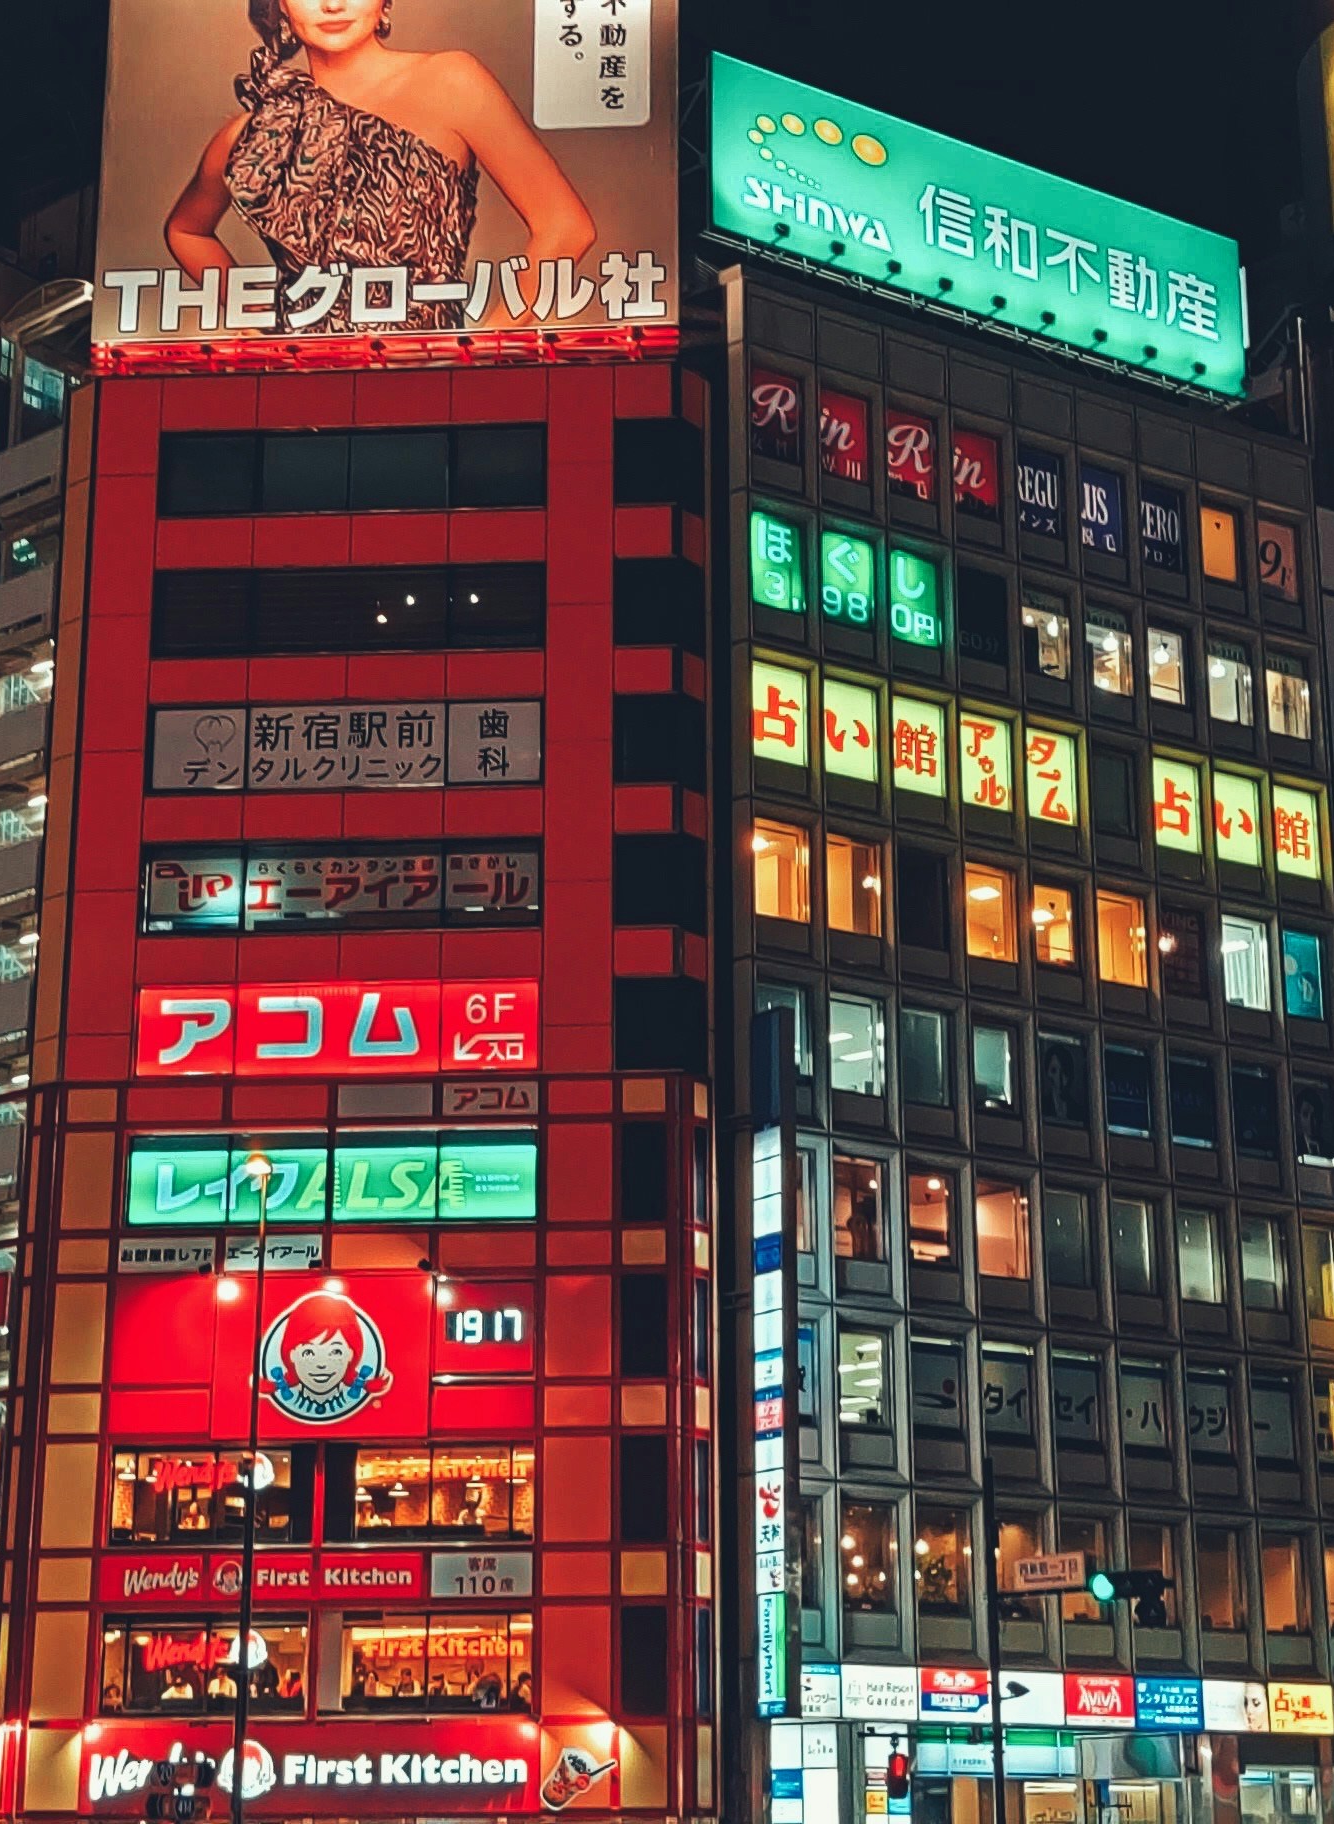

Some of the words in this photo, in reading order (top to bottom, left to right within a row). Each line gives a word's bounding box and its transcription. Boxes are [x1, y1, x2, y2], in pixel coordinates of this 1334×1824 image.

[918, 183, 1222, 341] 信和不動産
[103, 251, 668, 333] THEグローバル社
[757, 519, 925, 599] ほぐし
[254, 711, 437, 751] 新宿駅前
[477, 708, 510, 777] 歯科
[752, 684, 937, 779] 占い館
[183, 754, 443, 784] デンタルクリニック
[1153, 777, 1312, 860] 占い館
[247, 875, 529, 911] エーアイアール
[466, 993, 516, 1023] 6F
[159, 992, 421, 1064] アコム
[488, 1041, 525, 1061] 入口
[453, 1087, 531, 1111] アコム
[454, 1310, 484, 1344] 19
[494, 1309, 524, 1342] 17
[124, 1563, 199, 1598] Wendy's
[257, 1569, 309, 1588] First
[324, 1567, 412, 1588] Kitchen
[365, 1637, 424, 1659] First
[429, 1635, 524, 1659] Kitchen
[761, 1598, 774, 1696] FamilyMart
[867, 1695, 915, 1706] Garden
[1078, 1684, 1121, 1713] AVIVA
[284, 1755, 373, 1786] First
[381, 1752, 527, 1785] Kitchen
